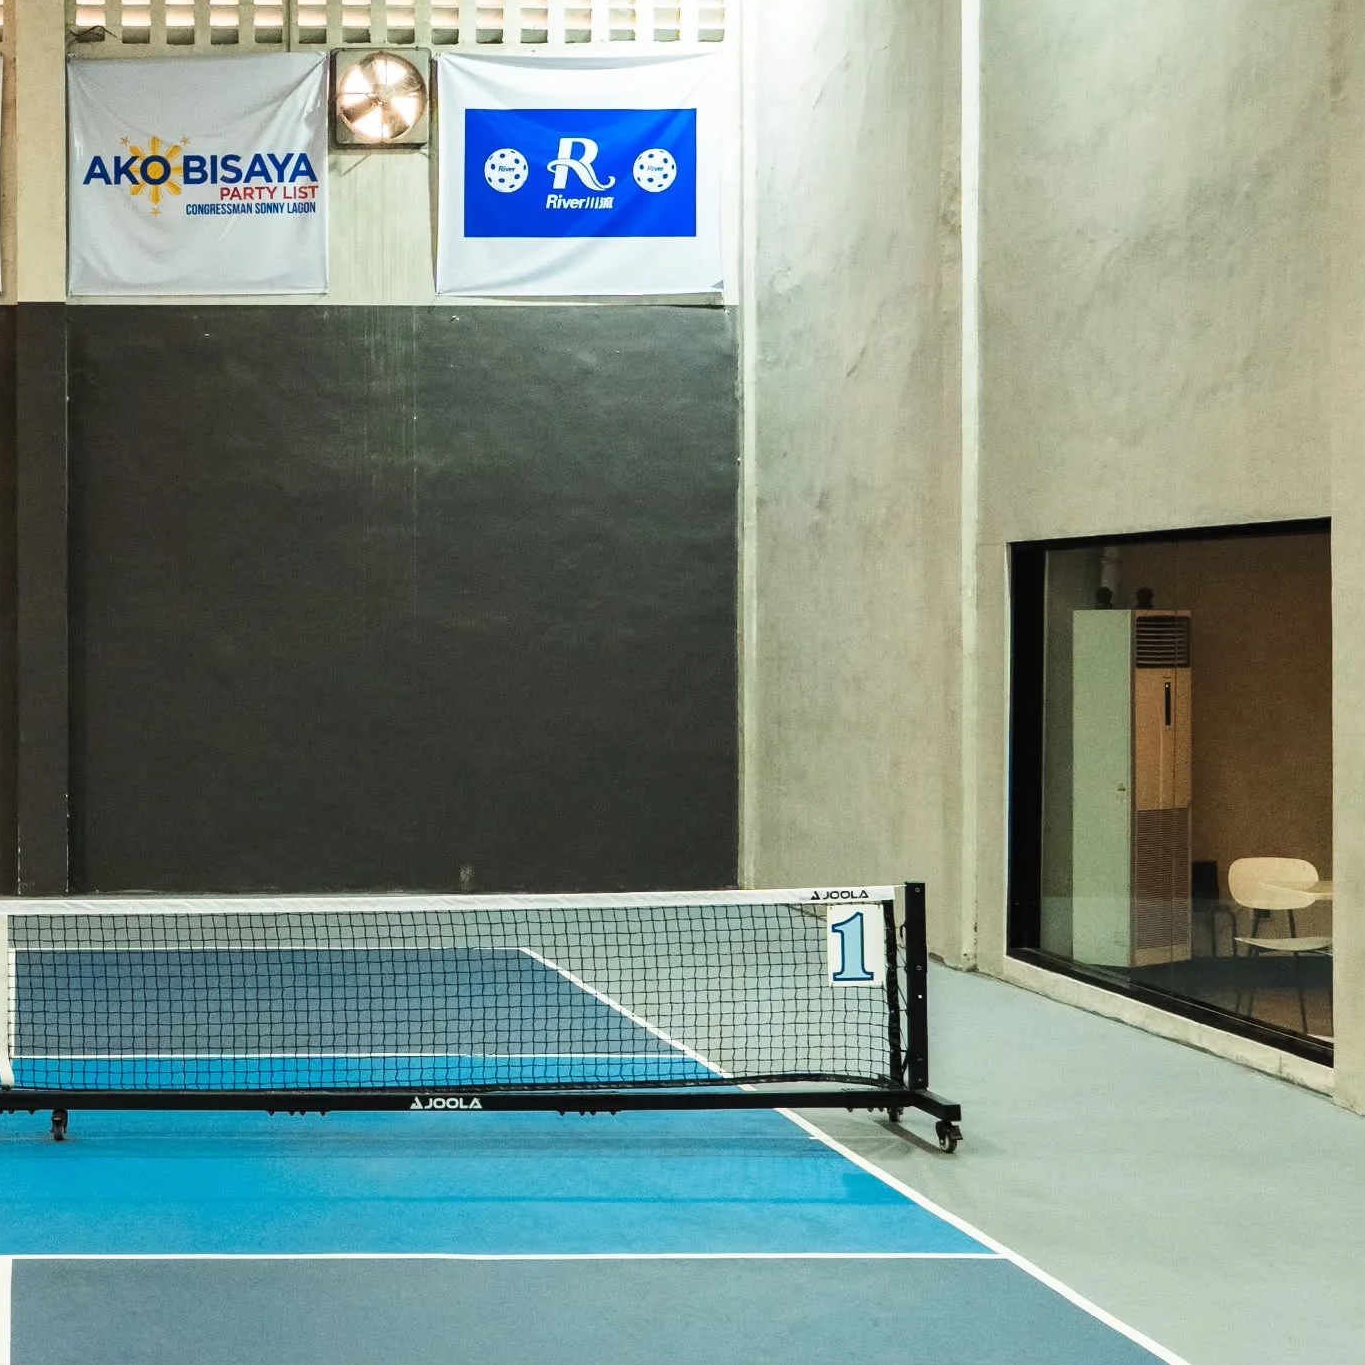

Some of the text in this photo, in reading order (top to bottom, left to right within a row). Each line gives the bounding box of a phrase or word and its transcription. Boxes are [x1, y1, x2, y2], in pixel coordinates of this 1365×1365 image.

[83, 153, 318, 185] AKO BISAYA
[220, 185, 319, 200] PARTY LIST
[186, 201, 316, 215] CONGRESSMAN SONNY LAGON
[822, 890, 869, 900] JOOLA
[831, 911, 874, 982] 1
[424, 1097, 483, 1109] JOOLA
